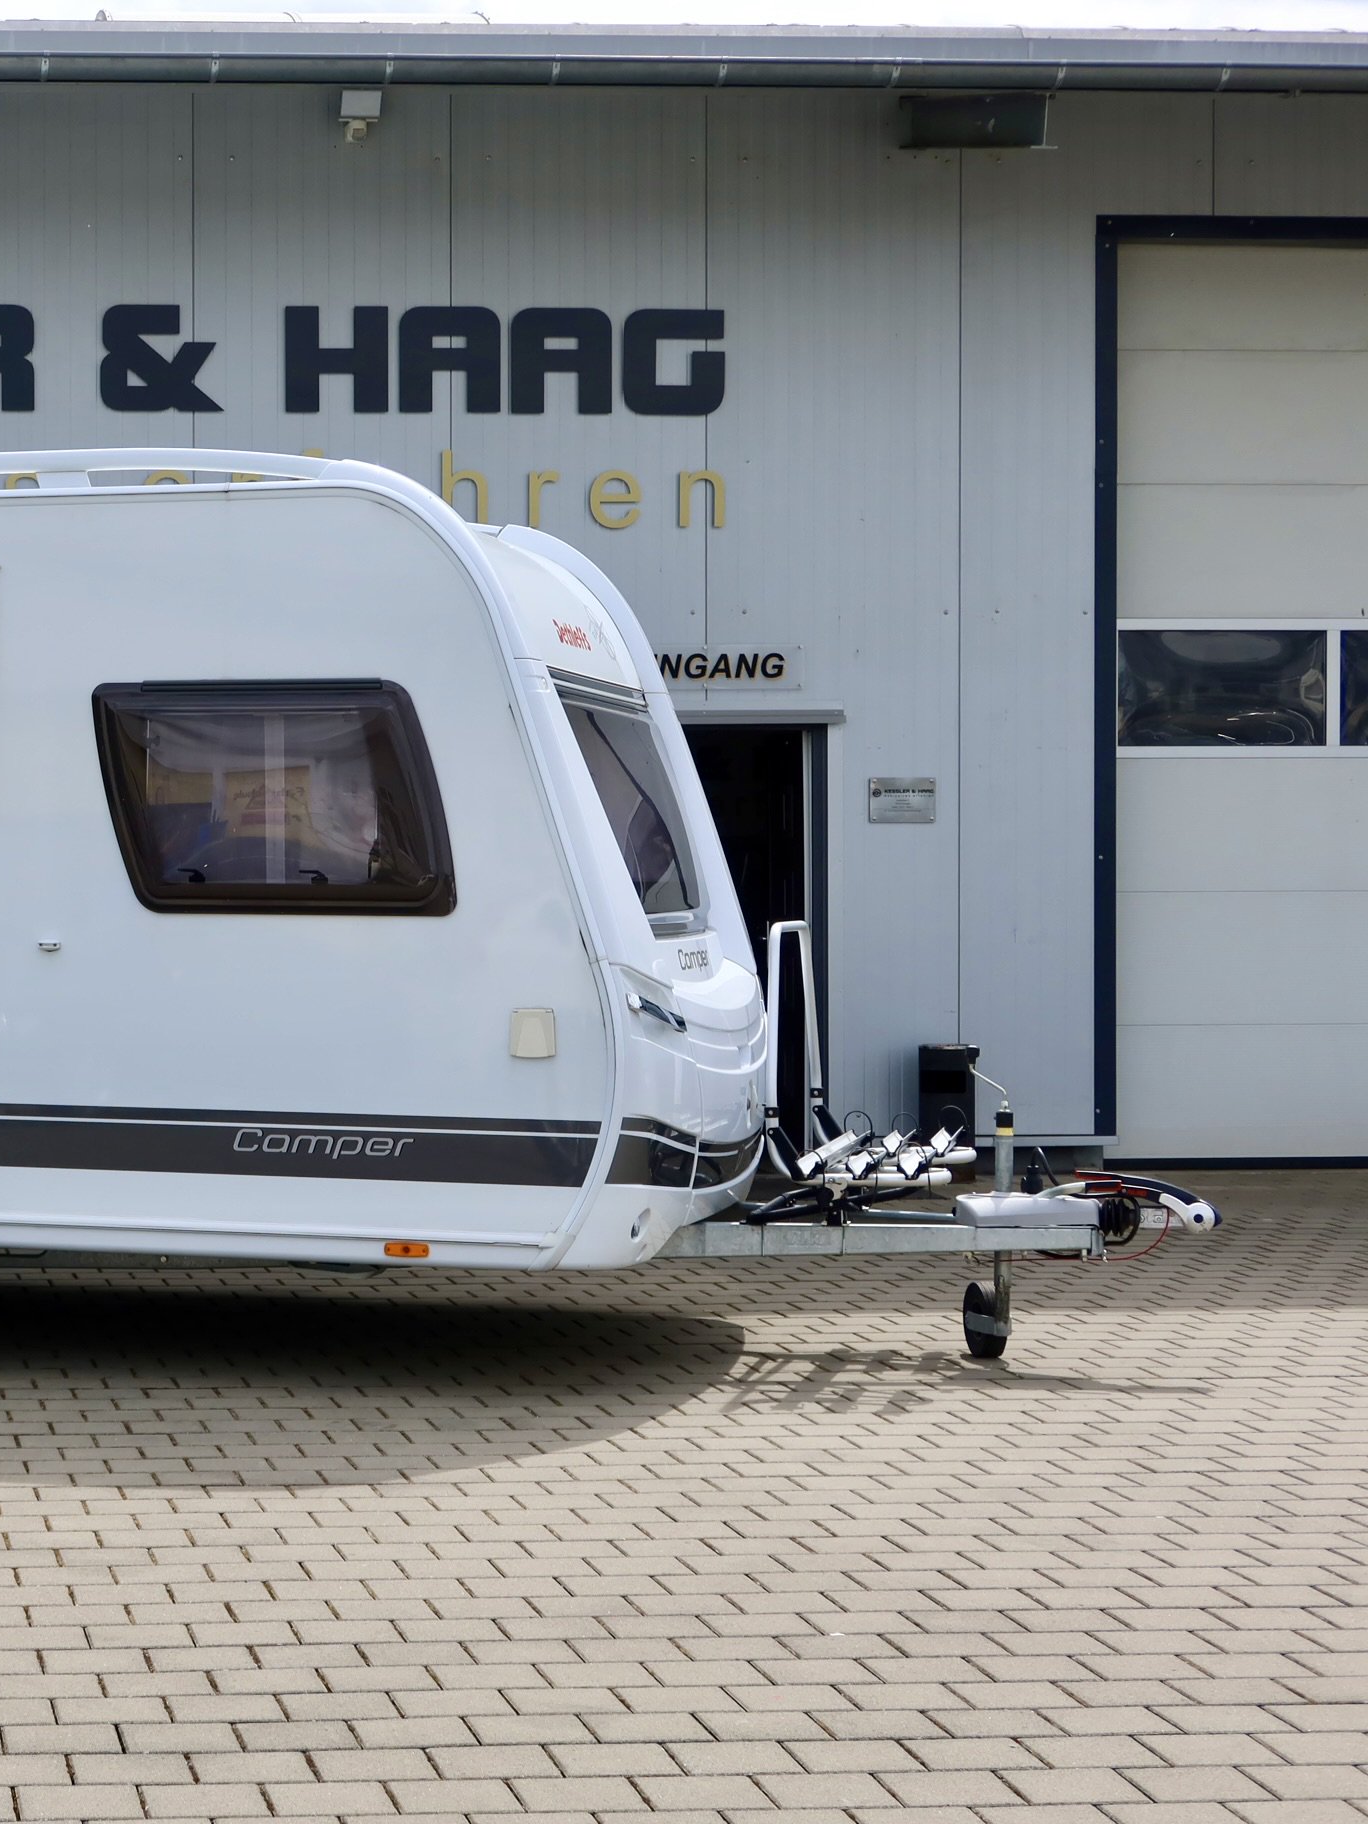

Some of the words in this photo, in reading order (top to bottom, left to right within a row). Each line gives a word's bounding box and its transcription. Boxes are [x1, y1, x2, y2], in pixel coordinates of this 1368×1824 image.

[99, 303, 224, 412] &
[284, 305, 725, 415] HAAG
[654, 652, 785, 679] NGANG
[233, 1128, 414, 1160] Camper
